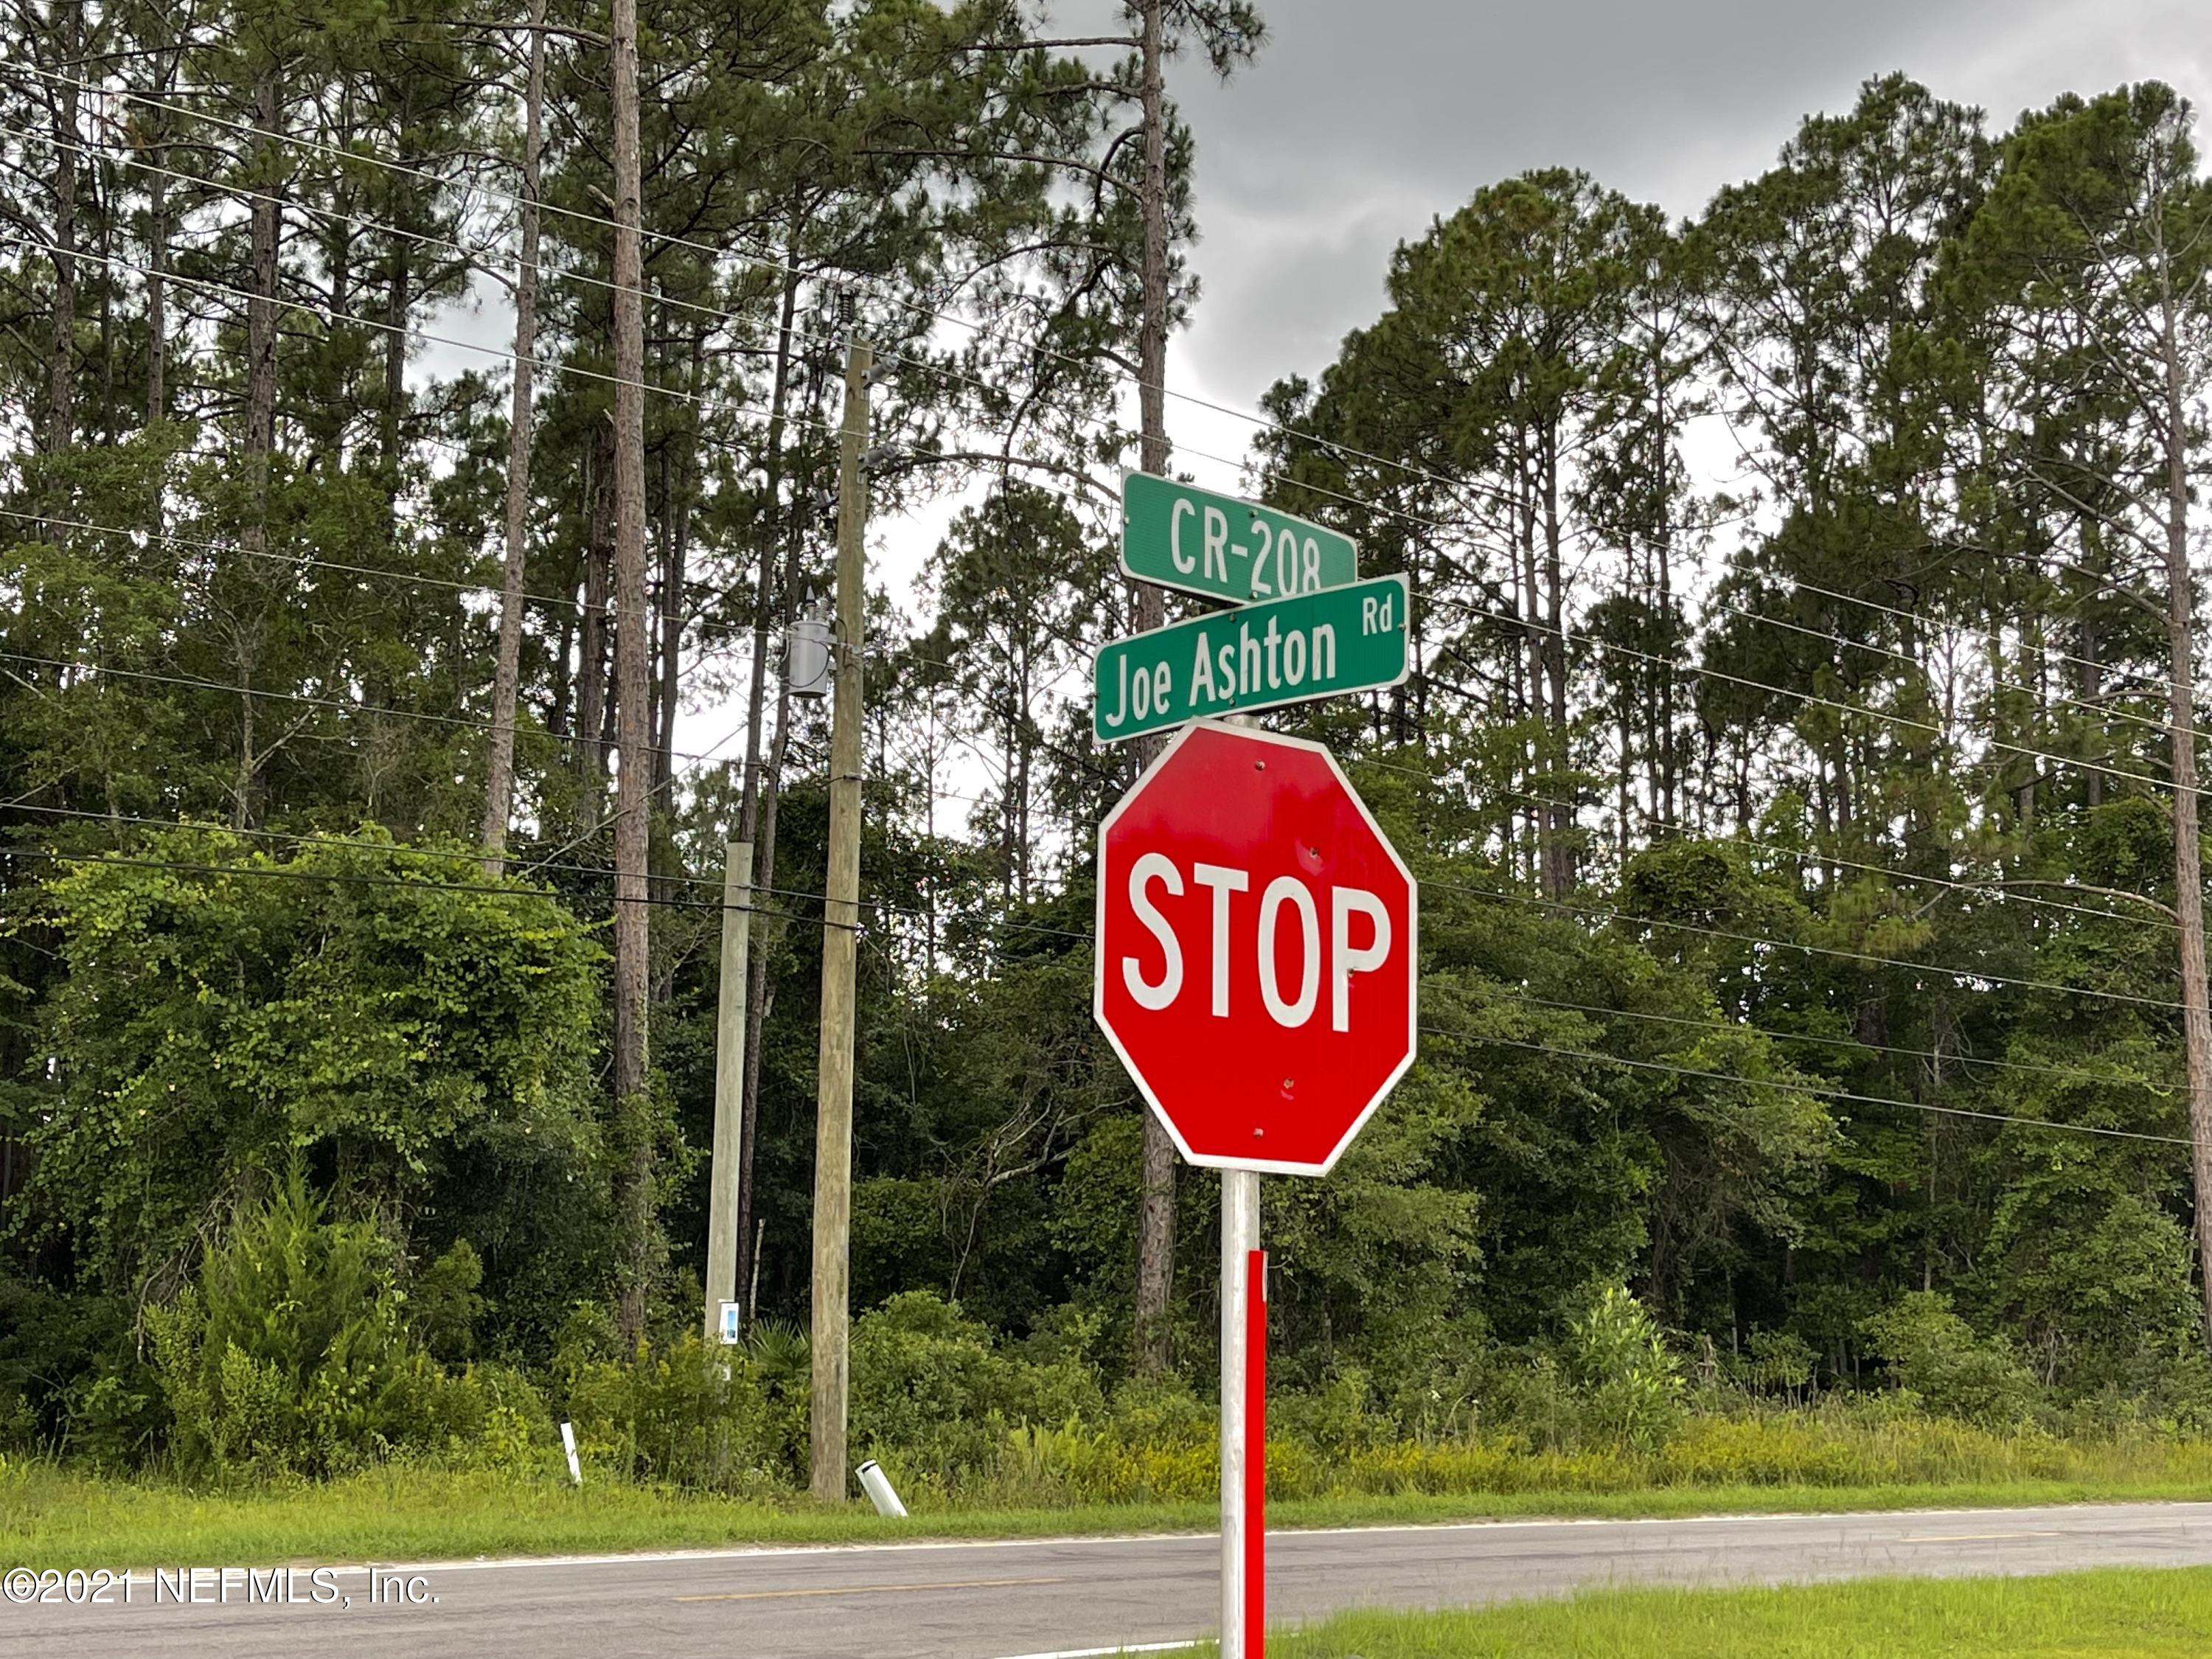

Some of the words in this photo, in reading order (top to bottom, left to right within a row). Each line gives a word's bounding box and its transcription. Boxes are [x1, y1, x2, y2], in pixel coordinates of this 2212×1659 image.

[1170, 498, 1321, 597] CR-208
[1105, 654, 1172, 727] Joe
[1189, 614, 1336, 707] Ashton
[1362, 592, 1393, 636] Rd
[1121, 852, 1392, 1032] STOP
